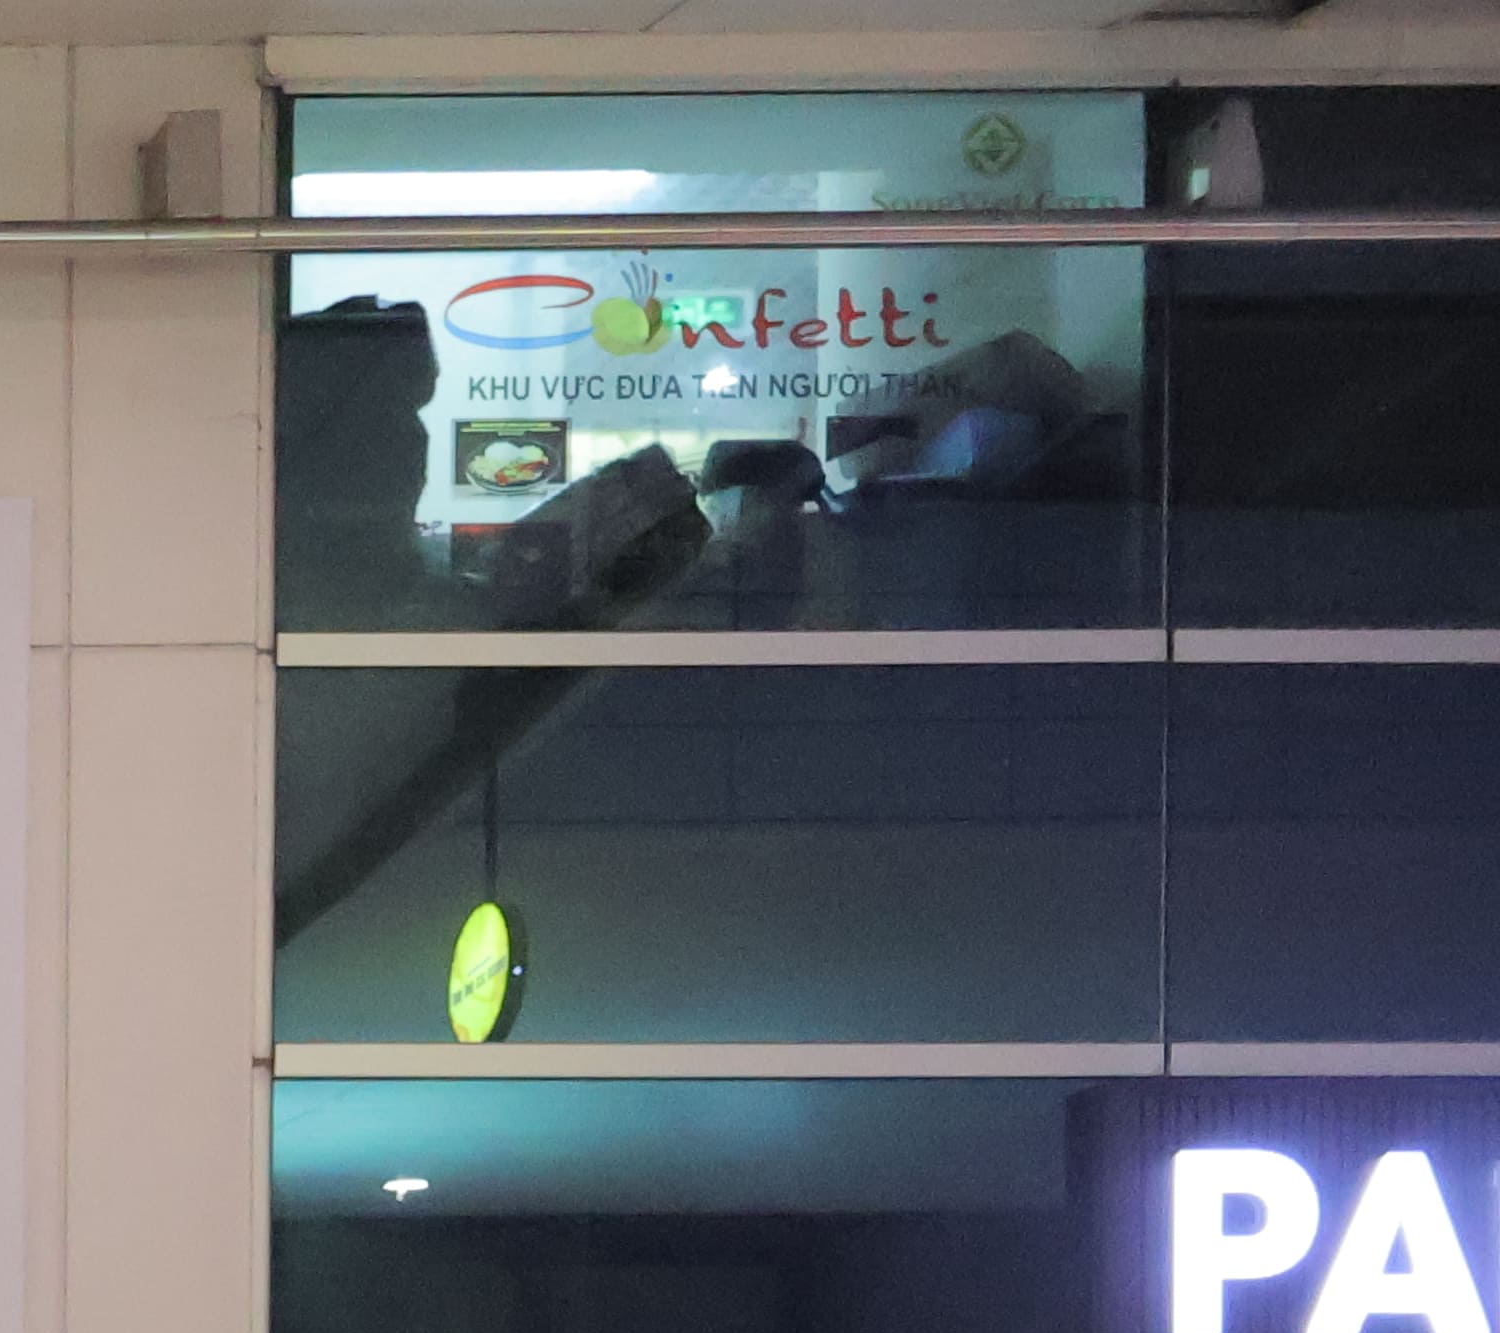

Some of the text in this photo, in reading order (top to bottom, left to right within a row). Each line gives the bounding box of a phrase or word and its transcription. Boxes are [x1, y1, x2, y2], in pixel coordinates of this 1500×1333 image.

[468, 375, 530, 401] KHU
[540, 374, 605, 405] VỰC
[615, 374, 684, 401] ĐƯA
